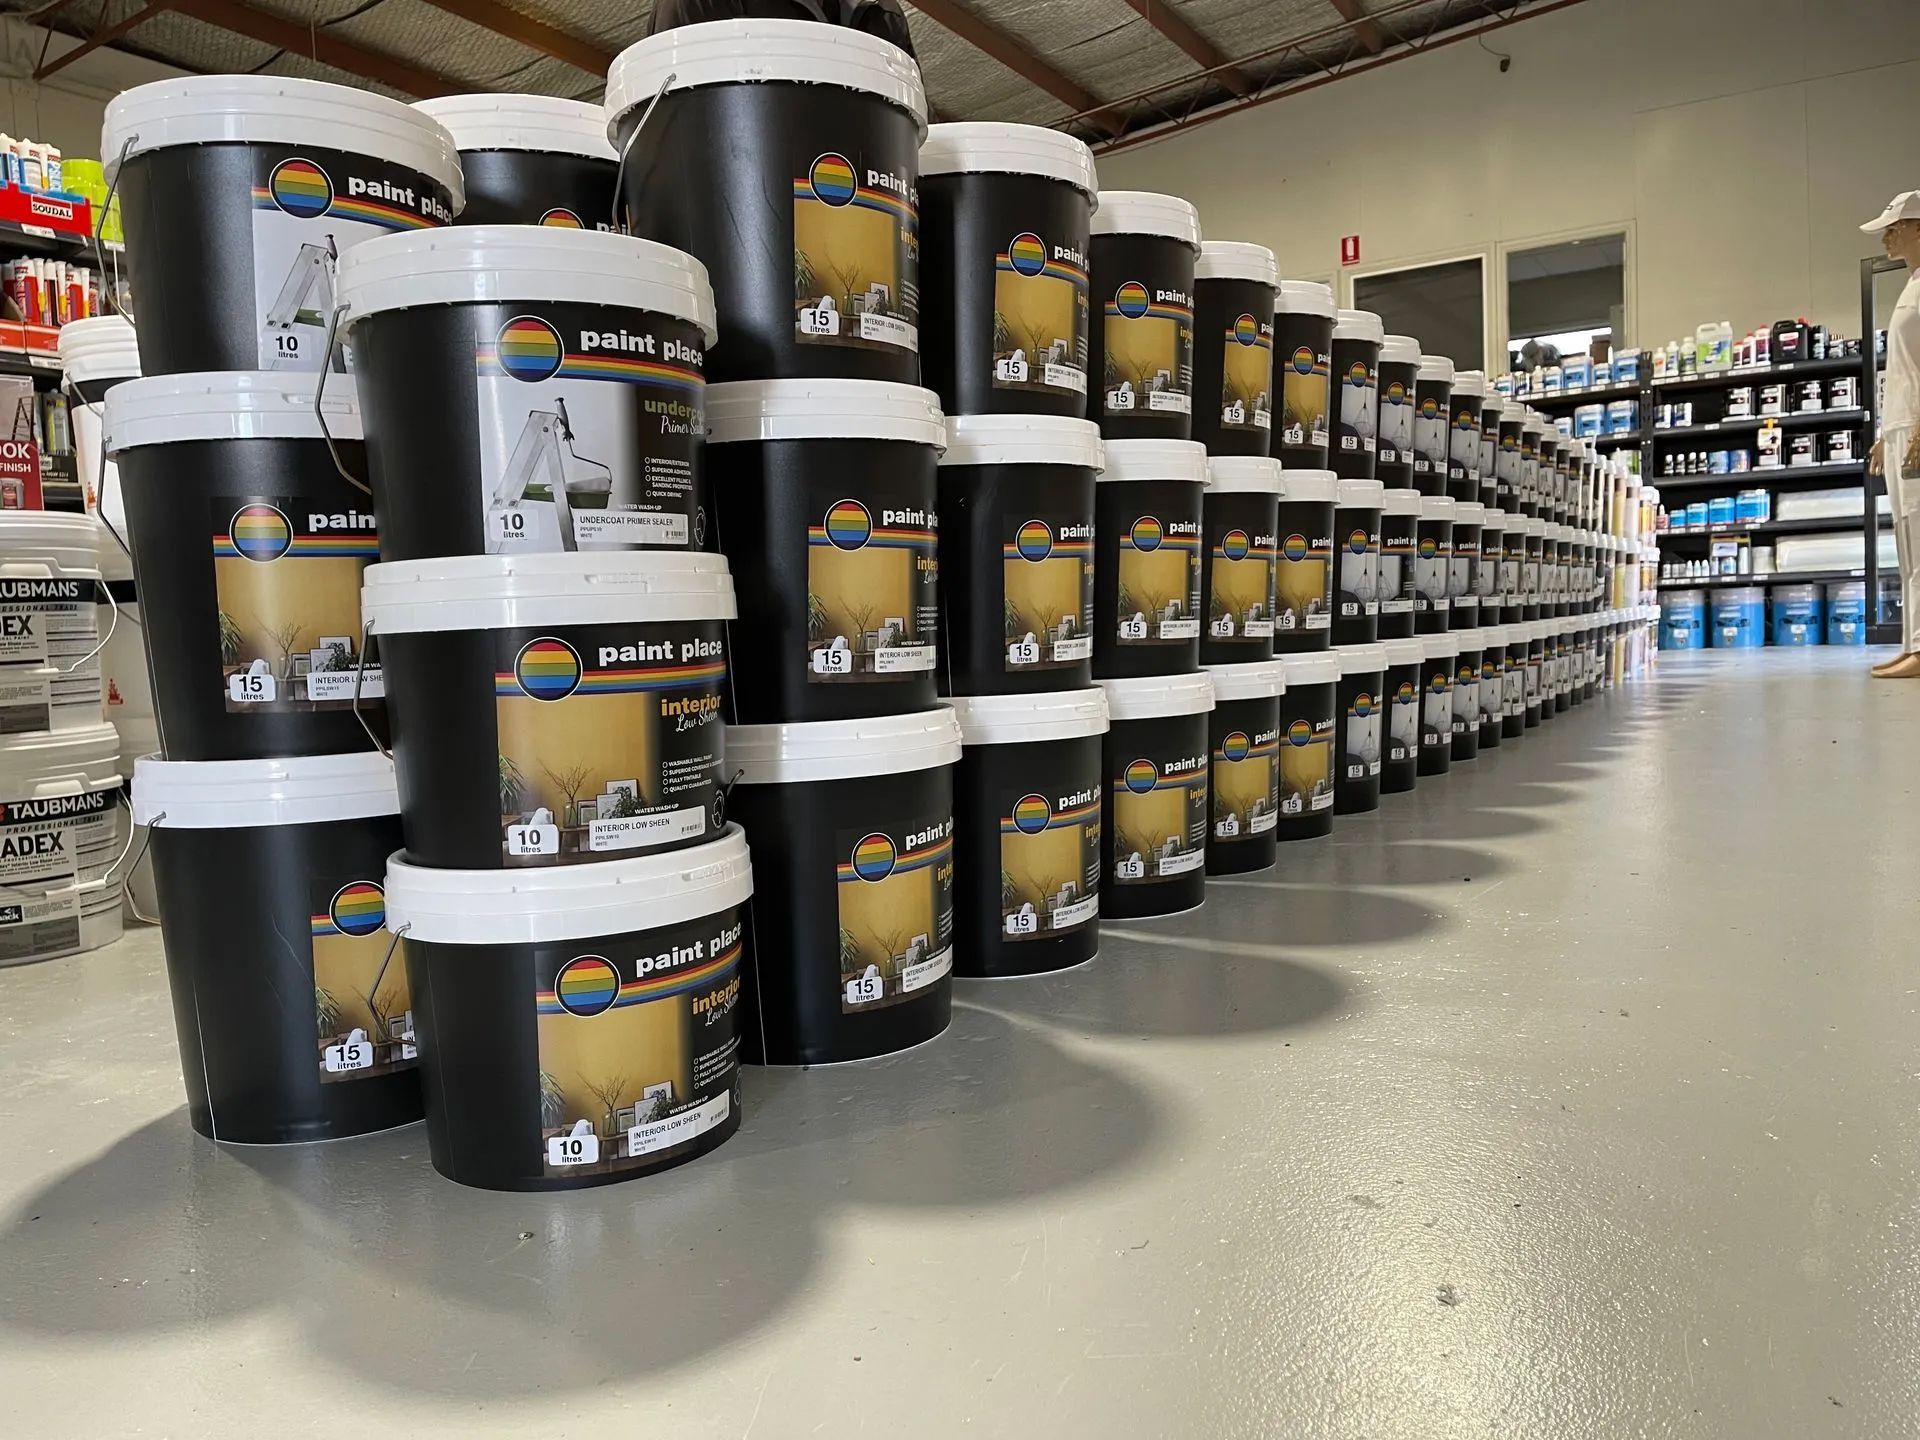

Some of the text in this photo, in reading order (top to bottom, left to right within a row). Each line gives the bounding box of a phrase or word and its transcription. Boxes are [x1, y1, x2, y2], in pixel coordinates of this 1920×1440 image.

[867, 169, 907, 195] paint
[349, 176, 415, 207] paint
[32, 202, 72, 218] SOUDAL
[1054, 245, 1083, 266] paint
[1157, 289, 1186, 303] paint
[809, 310, 830, 326] 15
[864, 318, 885, 328] INTERIOR
[810, 326, 830, 334] litres
[275, 335, 298, 351] 10
[580, 329, 703, 366] paint place
[278, 351, 299, 359] litres
[1004, 361, 1020, 374] 15
[1113, 393, 1128, 403] 15
[1229, 408, 1240, 418] 15
[660, 415, 690, 435] Primer
[1288, 430, 1299, 440] 15
[1345, 437, 1354, 445] 15
[1384, 450, 1392, 458] 15
[651, 475, 675, 483] EXCELLENT
[308, 510, 376, 532] pain
[500, 513, 524, 530] 10
[580, 516, 673, 527] UNDERCOAT PRIMER SEALER
[883, 508, 925, 526] paint
[503, 530, 525, 538] litres
[1060, 524, 1089, 540] paint
[1170, 521, 1196, 534] paint
[1254, 534, 1275, 546] paint
[1312, 537, 1331, 548] paint
[1387, 537, 1409, 546] paint
[0, 615, 33, 636] EX
[1216, 622, 1228, 632] 15
[1280, 616, 1290, 625] 15
[1127, 622, 1140, 633] 15
[598, 638, 722, 667] paint place
[1015, 644, 1032, 656] 15
[821, 650, 842, 665] 15
[822, 664, 842, 672] litres
[239, 676, 263, 692] 15
[315, 676, 350, 684] INTERIOR
[351, 675, 368, 684] LW
[241, 692, 264, 700] litres
[661, 694, 722, 716] interior
[675, 708, 718, 733] Low Sheen
[1255, 730, 1276, 745] paint
[1165, 756, 1195, 774] paint
[669, 784, 688, 793] QUALITY
[8, 793, 104, 820] TAUBMANS
[1059, 789, 1091, 811] paint
[1287, 800, 1298, 809] 15
[634, 807, 654, 815] WATER
[6, 819, 78, 834] PROFESSIONAL
[595, 818, 670, 833] INTERIOR LOW SHEEN
[1222, 822, 1234, 832] 15
[517, 829, 541, 846] 10
[905, 823, 943, 851] paint
[520, 845, 542, 853] litres
[1123, 862, 1137, 873] 15
[1013, 915, 1029, 927] 15
[636, 922, 742, 978] paint place
[906, 966, 925, 978] INTERIOR
[855, 979, 874, 994] 15
[692, 976, 741, 1015] interior
[855, 993, 874, 1001] litres
[705, 1008, 723, 1027] Low
[335, 1044, 361, 1062] 15
[337, 1061, 362, 1070] litres
[699, 1069, 712, 1078] FULLY
[669, 1104, 687, 1115] WATER
[633, 1112, 701, 1140] INTERIOR LOW SHEEN
[559, 1140, 583, 1156] 10
[561, 1155, 583, 1163] litres
